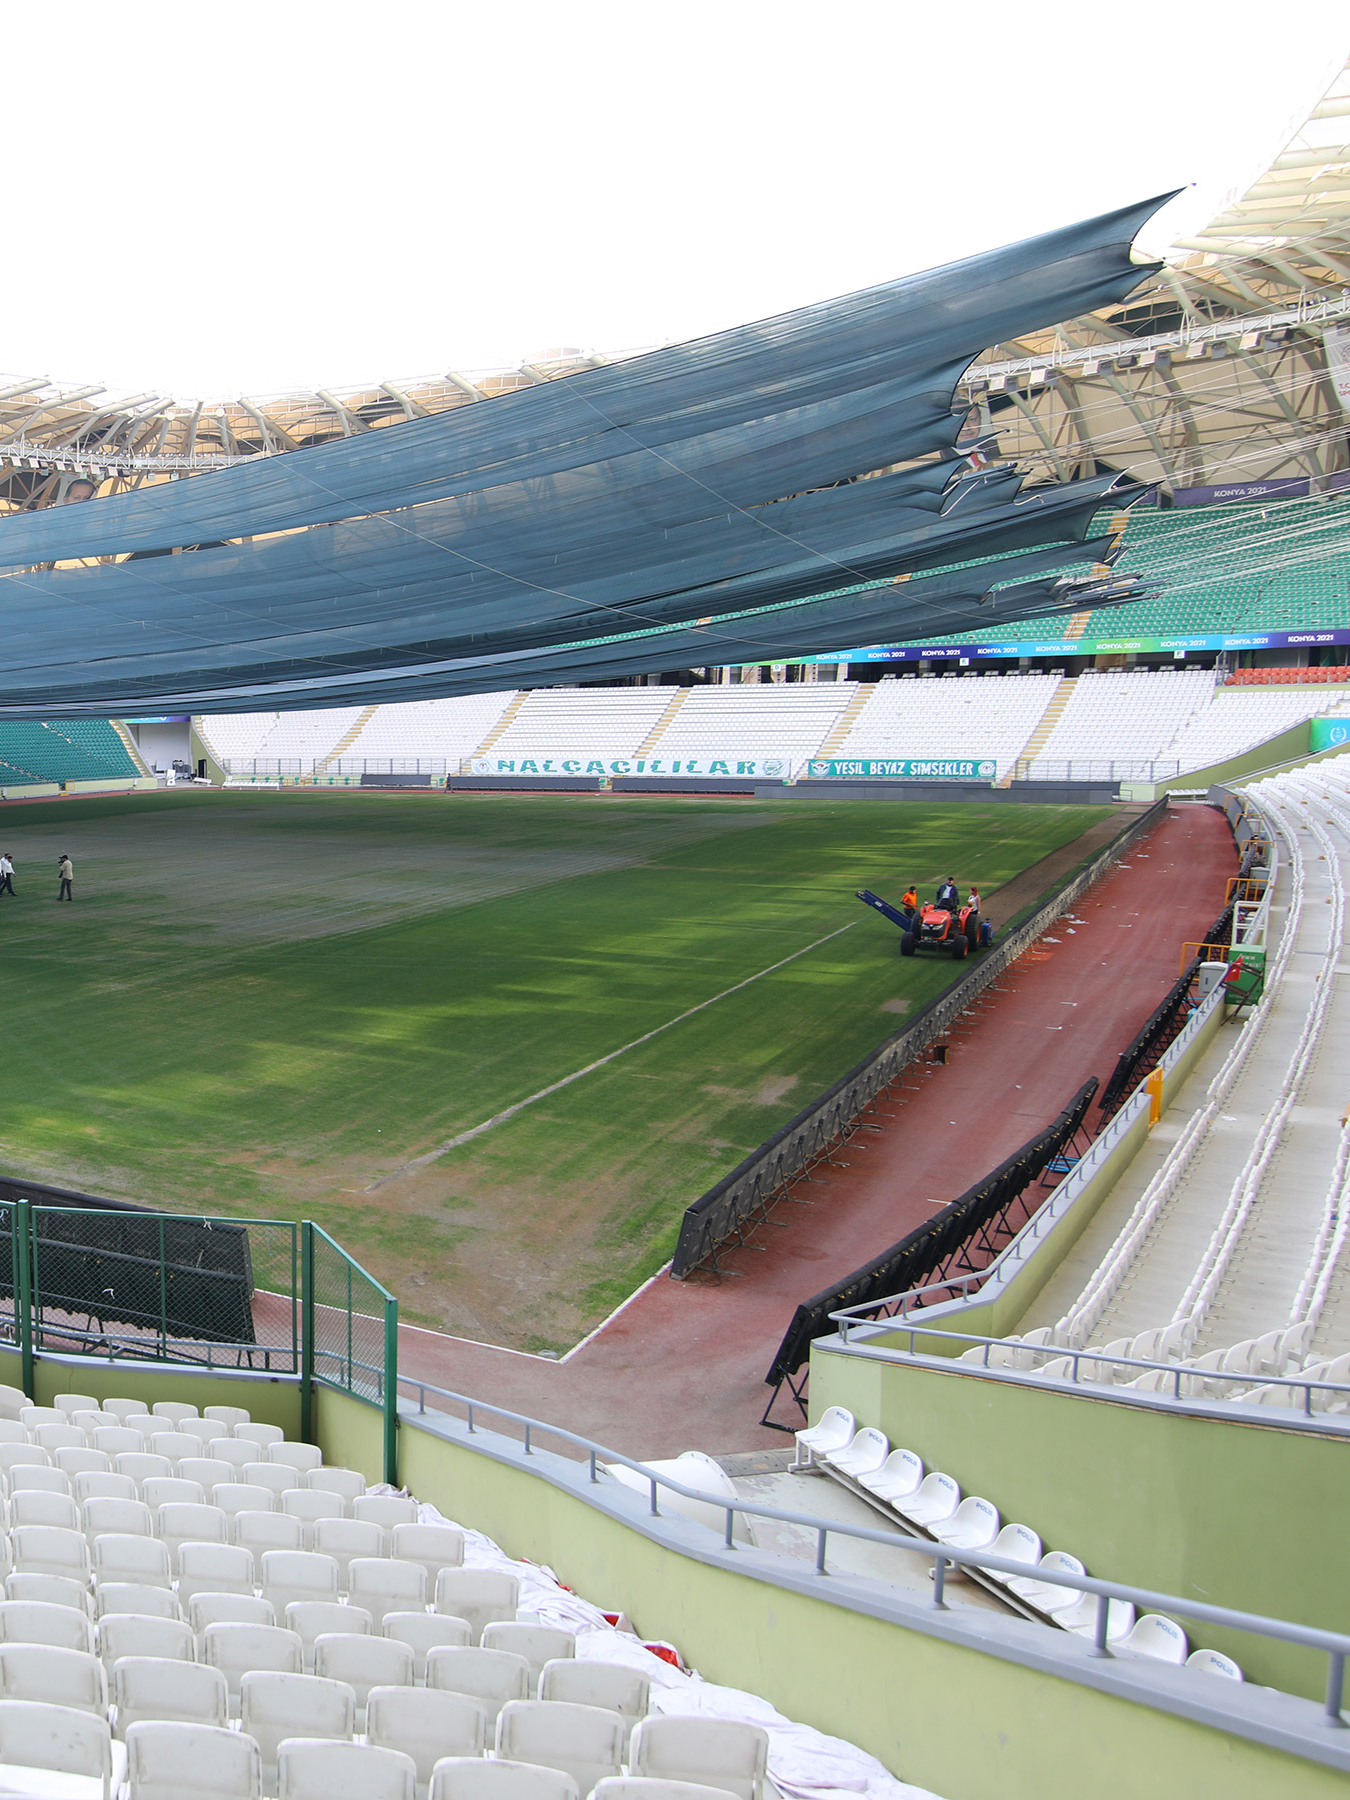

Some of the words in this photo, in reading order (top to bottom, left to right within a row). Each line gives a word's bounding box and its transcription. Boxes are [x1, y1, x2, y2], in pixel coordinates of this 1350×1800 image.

[1213, 488, 1246, 498] KONYA
[1246, 486, 1267, 495] 2021
[1224, 638, 1251, 646] KONYA
[1287, 635, 1316, 643] KONYA
[1160, 640, 1188, 648] KONYA
[816, 653, 838, 661] KONYA
[870, 761, 906, 775] BEYAZ
